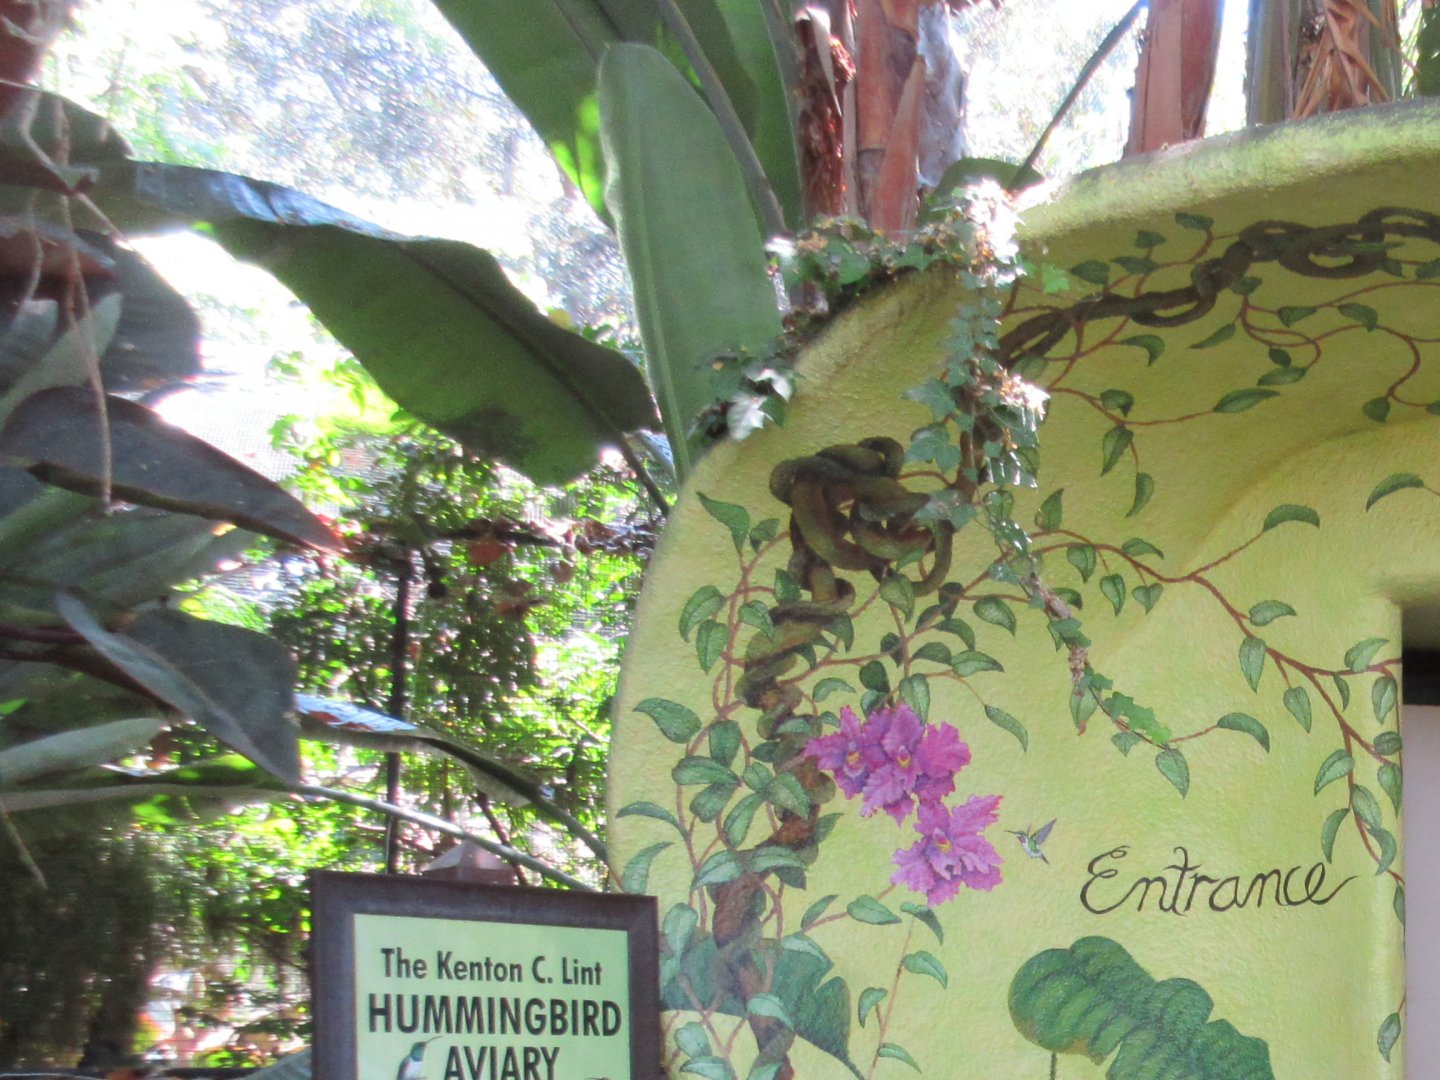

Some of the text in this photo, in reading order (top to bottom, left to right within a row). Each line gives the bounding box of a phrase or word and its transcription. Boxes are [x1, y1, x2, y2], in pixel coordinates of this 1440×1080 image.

[1080, 845, 1359, 916] Entrance
[381, 947, 603, 985] The Kenton C. Lint
[368, 993, 622, 1037] HUMMINGBIRD
